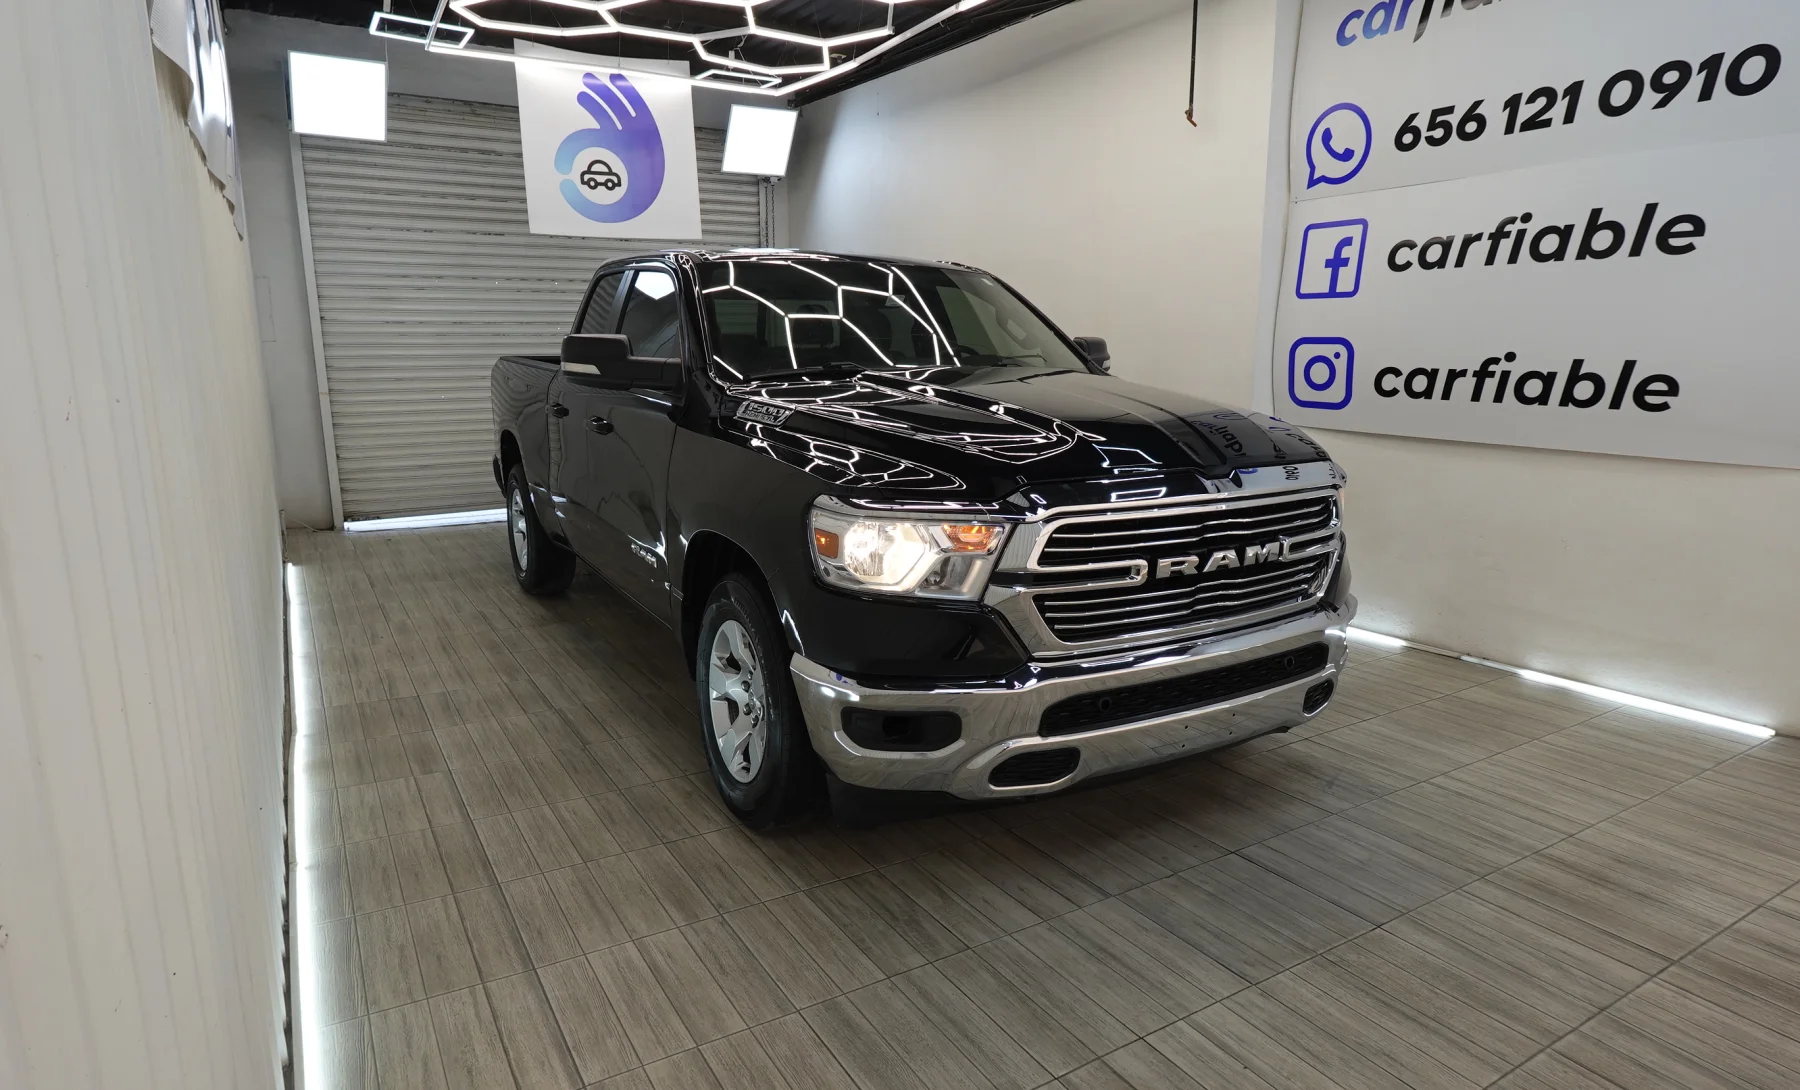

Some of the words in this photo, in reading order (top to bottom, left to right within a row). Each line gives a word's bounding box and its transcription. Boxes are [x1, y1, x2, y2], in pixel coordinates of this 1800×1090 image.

[1393, 100, 1487, 153] 656
[1502, 80, 1585, 136] 121
[1597, 43, 1783, 118] 0910
[1387, 202, 1707, 273] carfiable
[1373, 351, 1681, 413] carfiable
[748, 402, 785, 416] 1500
[631, 543, 657, 568] RAM
[1156, 541, 1280, 579] RAM
